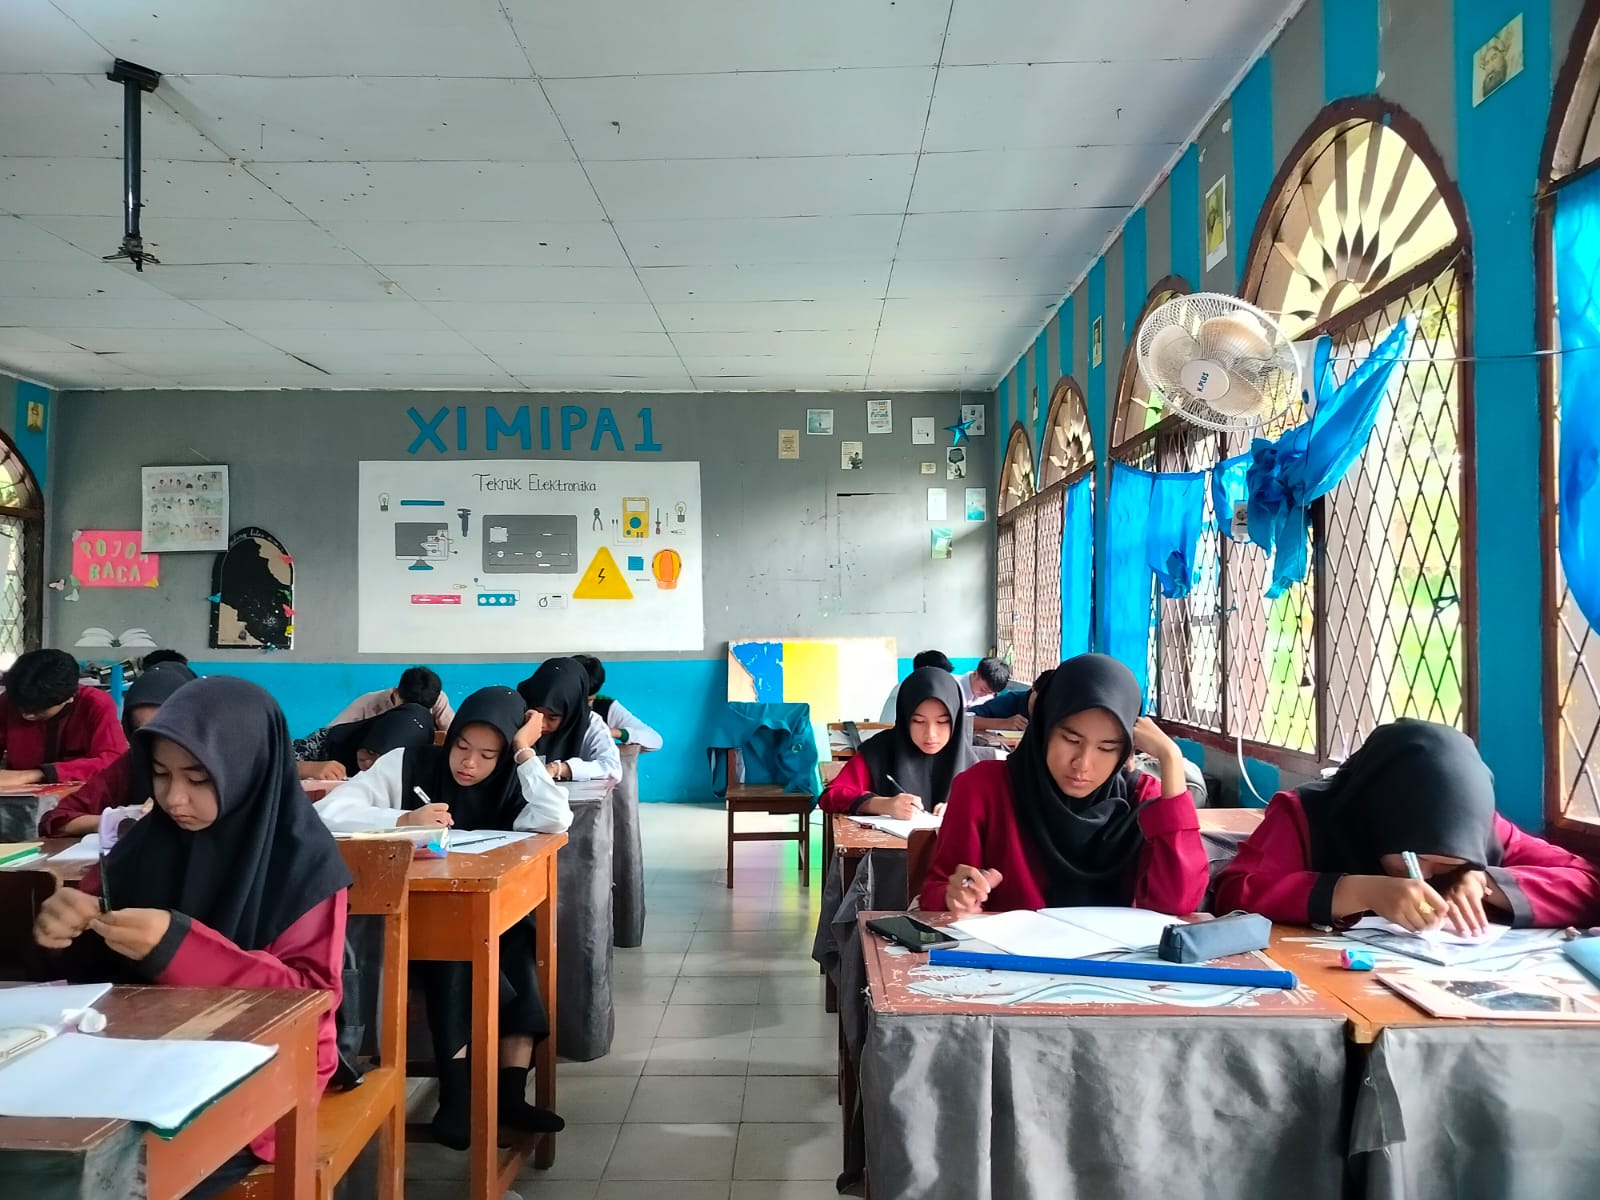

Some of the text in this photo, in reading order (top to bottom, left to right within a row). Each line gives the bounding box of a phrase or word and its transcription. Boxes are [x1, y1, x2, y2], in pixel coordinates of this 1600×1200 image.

[406, 405, 663, 455] XI MIPA 1
[472, 473, 597, 493] Teknik Elektronika
[89, 561, 141, 583] BACA
